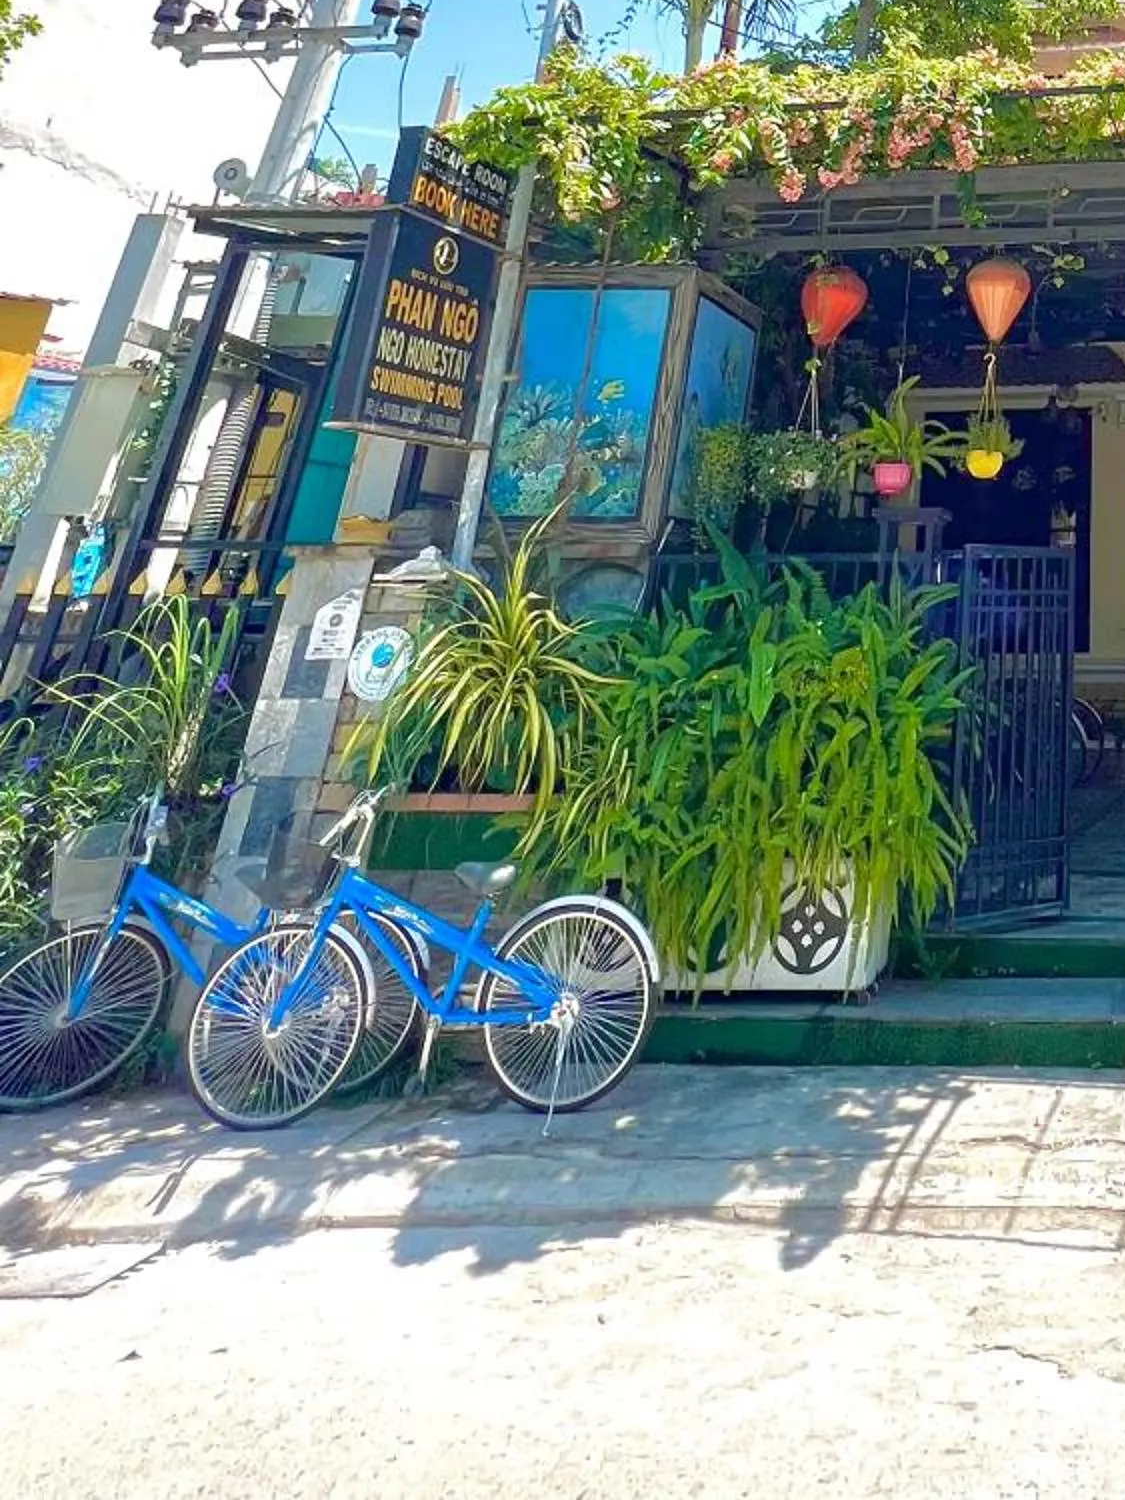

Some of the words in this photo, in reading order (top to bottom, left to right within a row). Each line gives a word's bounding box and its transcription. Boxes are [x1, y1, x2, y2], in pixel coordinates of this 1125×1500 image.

[424, 137, 471, 177] ESCAPE
[474, 163, 508, 194] ROOM
[414, 176, 458, 220] BOOK
[460, 198, 500, 240] HERE
[386, 280, 438, 332] PHAN
[375, 326, 406, 366] NGO
[404, 336, 473, 383] HOMESTAY
[370, 365, 436, 403] SWIMMING
[436, 383, 464, 411] POOL
